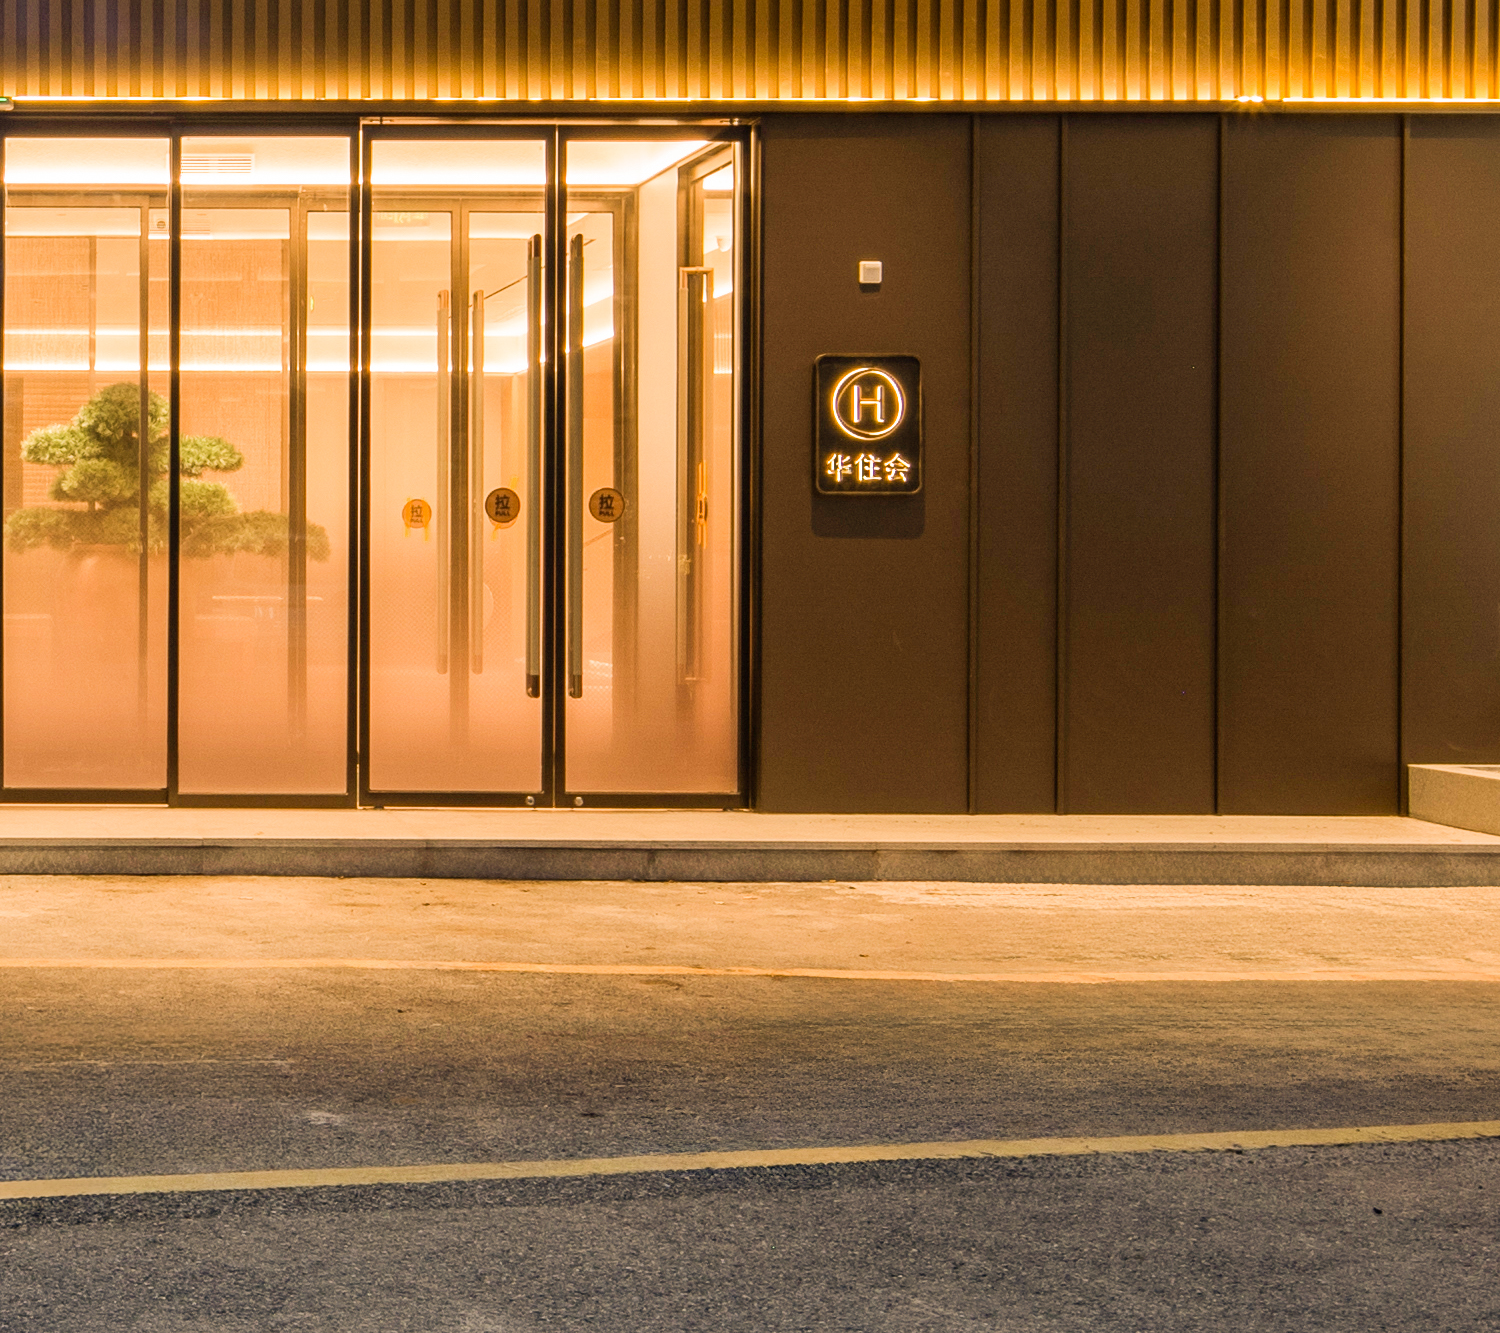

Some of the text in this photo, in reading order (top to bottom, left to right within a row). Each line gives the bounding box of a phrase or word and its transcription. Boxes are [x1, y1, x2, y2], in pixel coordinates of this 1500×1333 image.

[826, 453, 911, 482] 华住会
[495, 494, 510, 510] 拉
[600, 494, 614, 509] 拉
